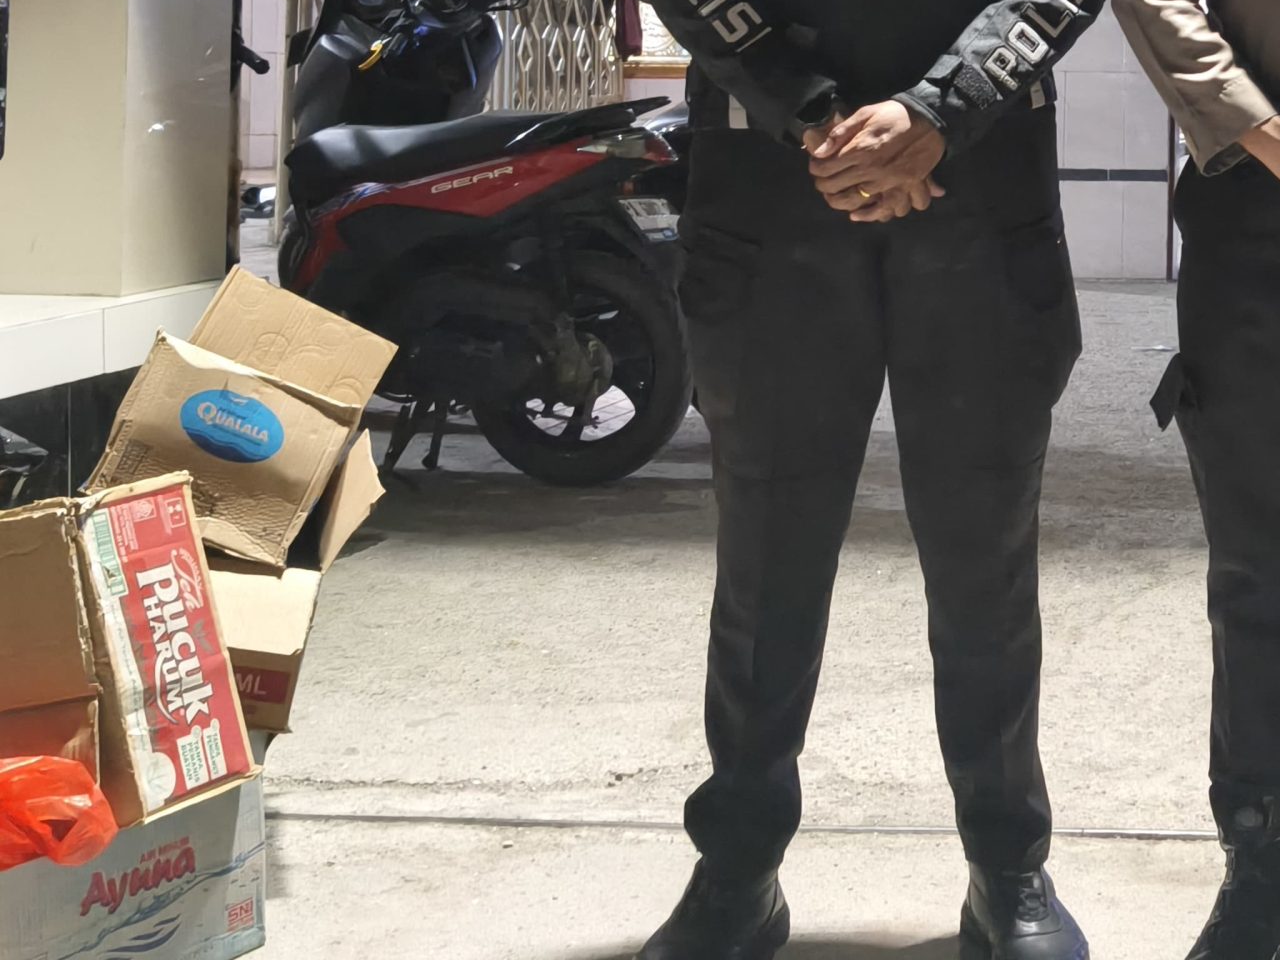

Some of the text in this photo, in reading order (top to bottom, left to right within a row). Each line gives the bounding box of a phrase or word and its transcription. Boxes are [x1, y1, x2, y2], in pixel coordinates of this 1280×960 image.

[431, 166, 514, 194] GEAR
[143, 597, 184, 714] HARUM
[193, 740, 204, 770] TANPA
